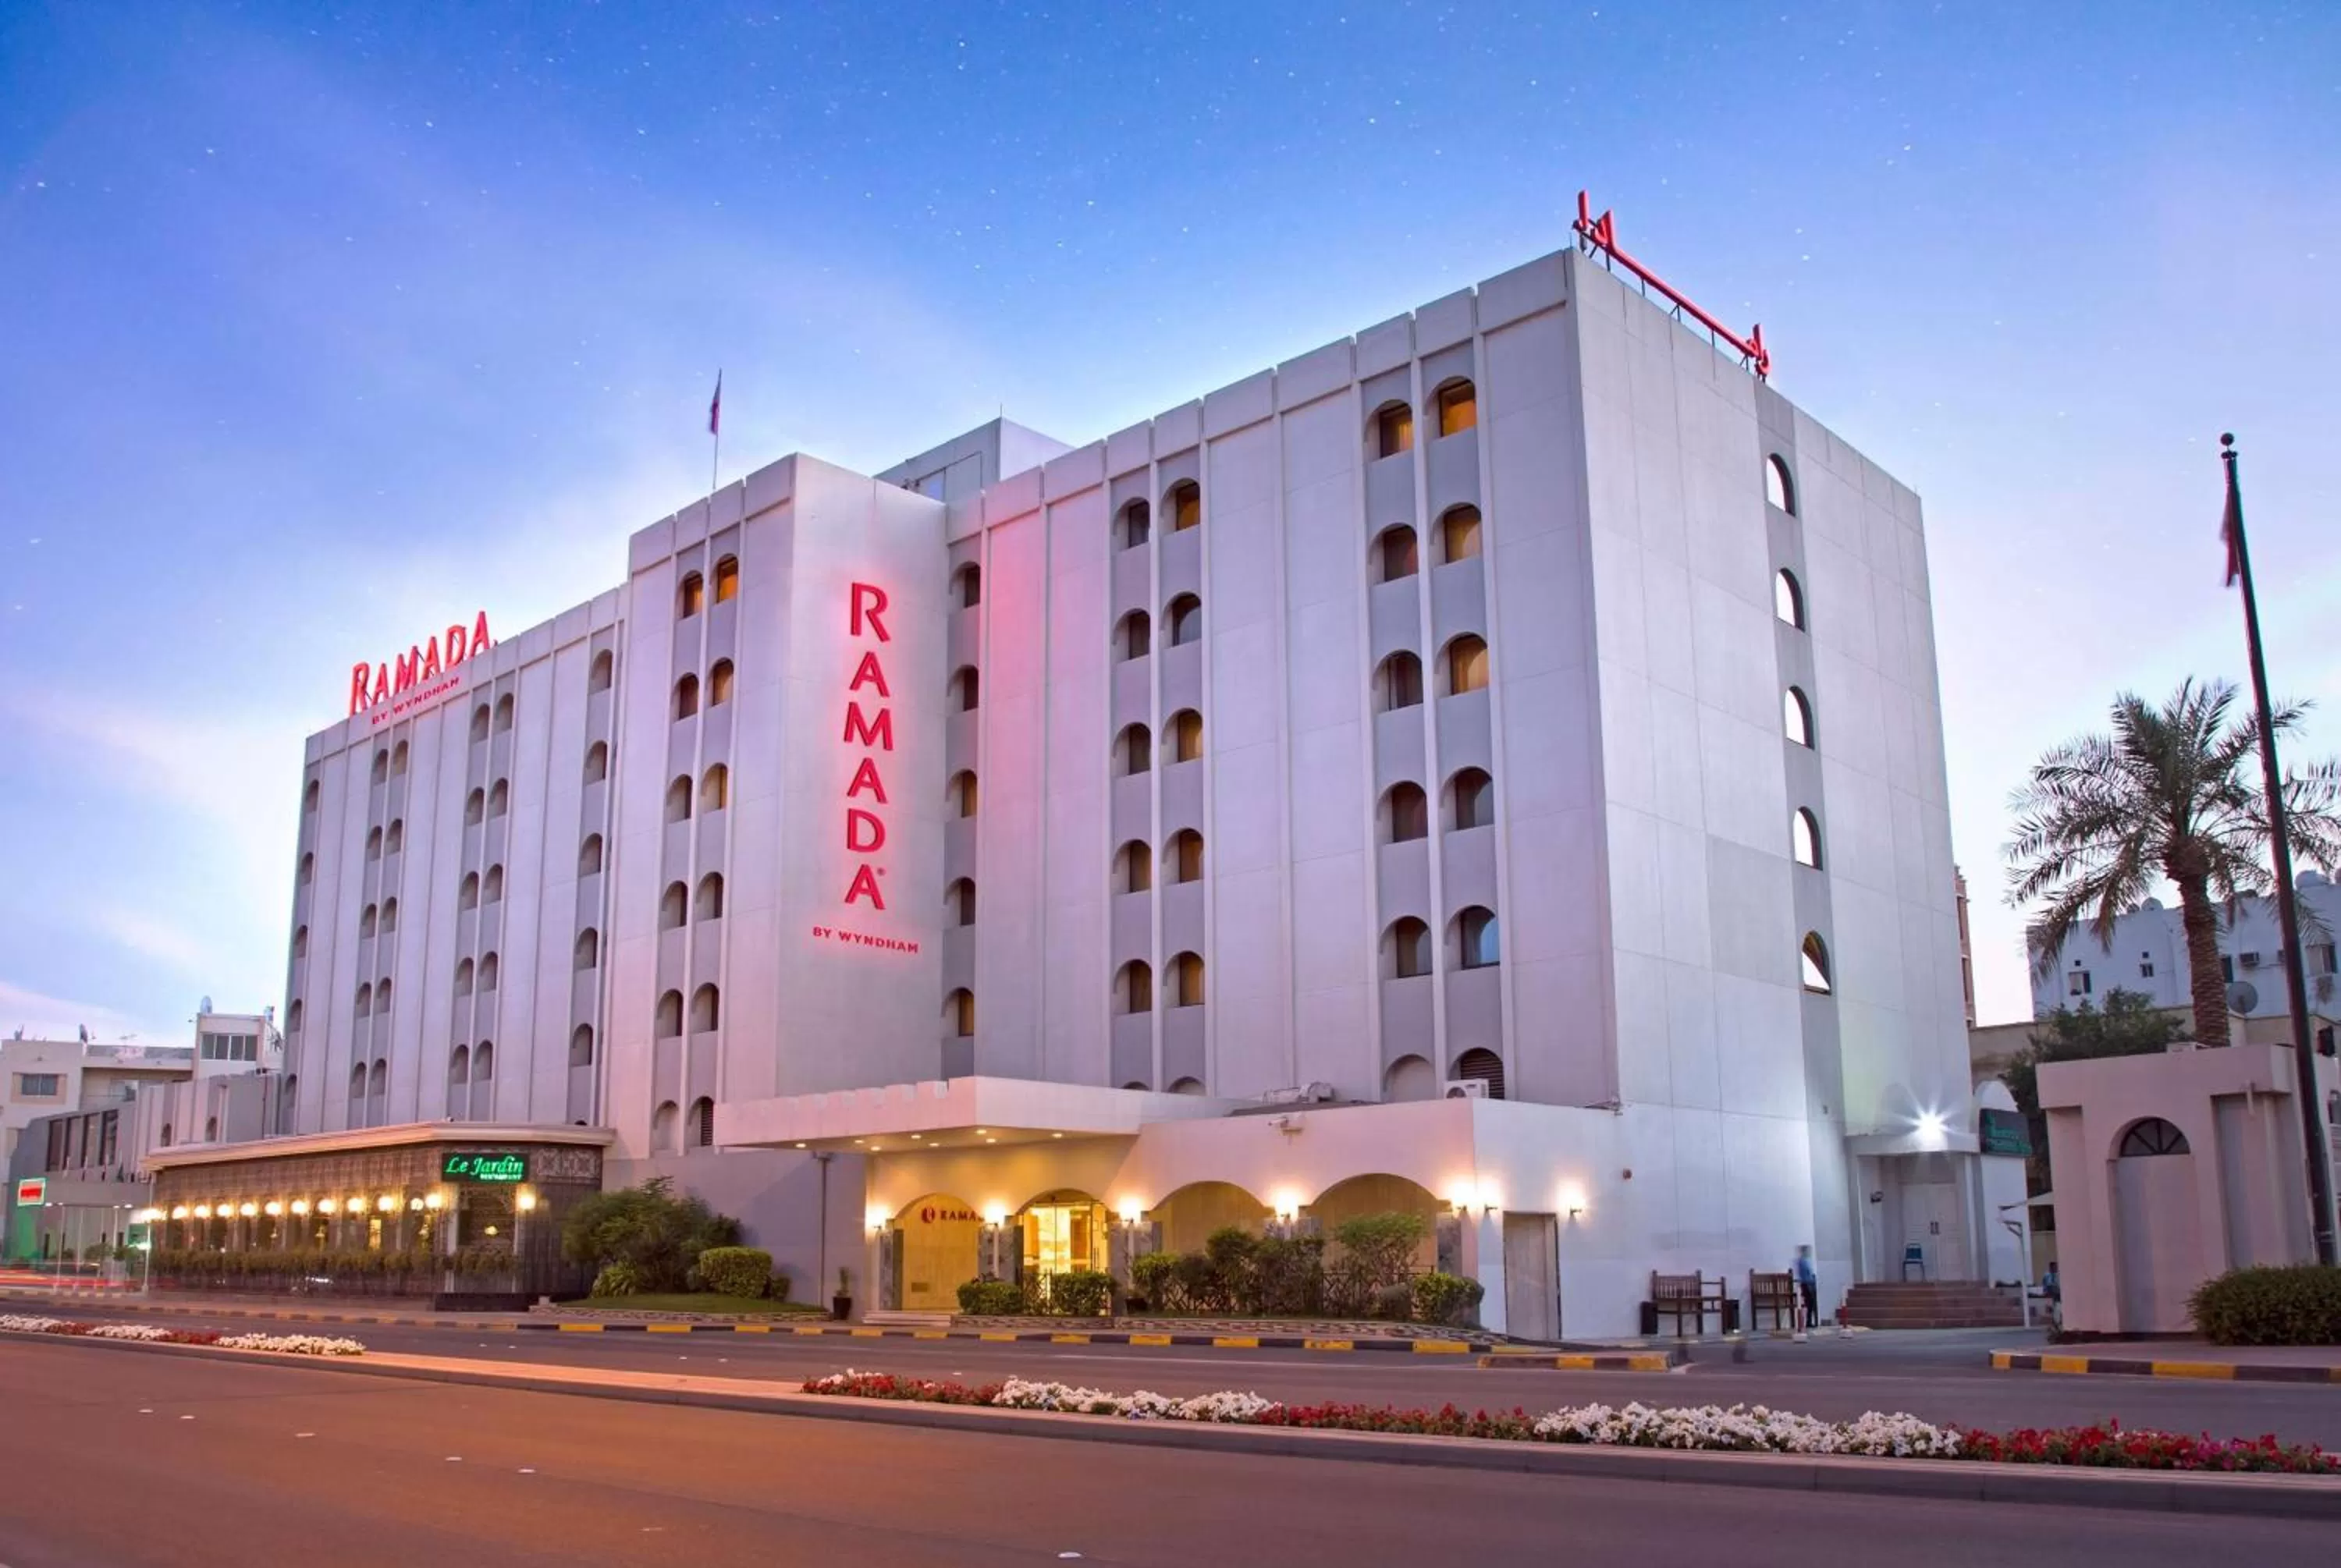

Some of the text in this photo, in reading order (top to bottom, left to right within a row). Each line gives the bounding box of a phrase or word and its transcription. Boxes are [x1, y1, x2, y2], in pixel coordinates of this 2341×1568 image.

[349, 609, 489, 715] RAMADA
[372, 676, 460, 725] BY WYNDHAM
[844, 581, 893, 910] RAMADA
[813, 926, 918, 953] BY WYNDHAM
[446, 1155, 523, 1176] Le Jardin
